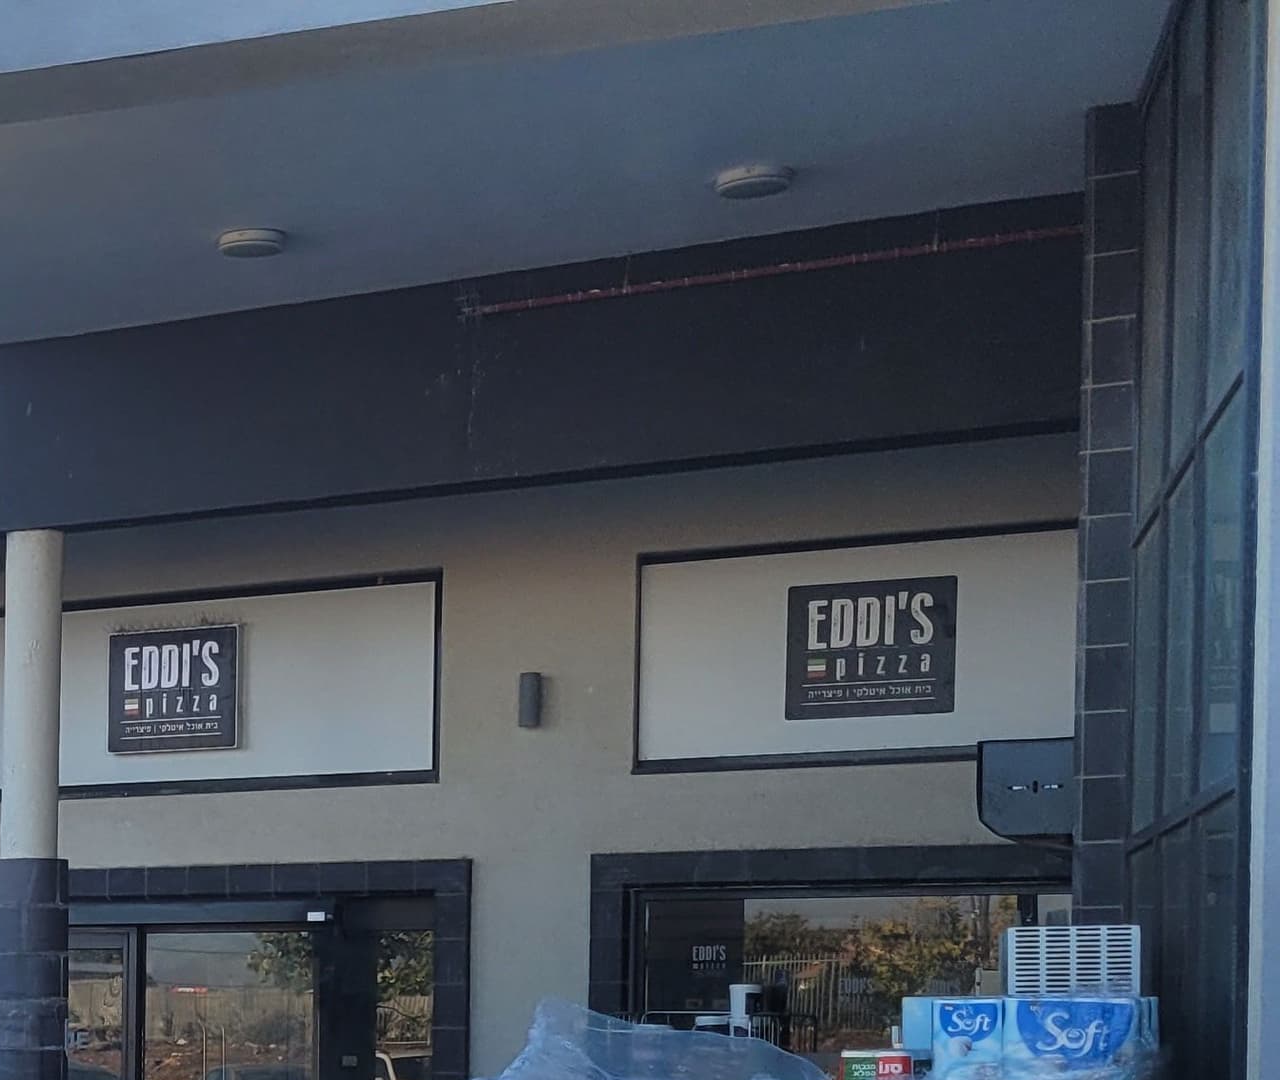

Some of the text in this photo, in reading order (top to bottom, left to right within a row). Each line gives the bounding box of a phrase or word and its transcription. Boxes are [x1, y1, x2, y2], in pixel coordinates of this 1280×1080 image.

[807, 591, 934, 650] EDDI'S
[124, 640, 219, 691] EDDI'S
[836, 653, 931, 681] pizza
[853, 686, 886, 698] איטלקי
[890, 685, 912, 696] אוכל
[915, 685, 932, 695] בית
[146, 693, 217, 719] pizza
[186, 721, 203, 731] אוכל
[692, 944, 727, 961] EDDI'S
[948, 1009, 991, 1035] Soft
[1037, 1012, 1110, 1058] Soft
